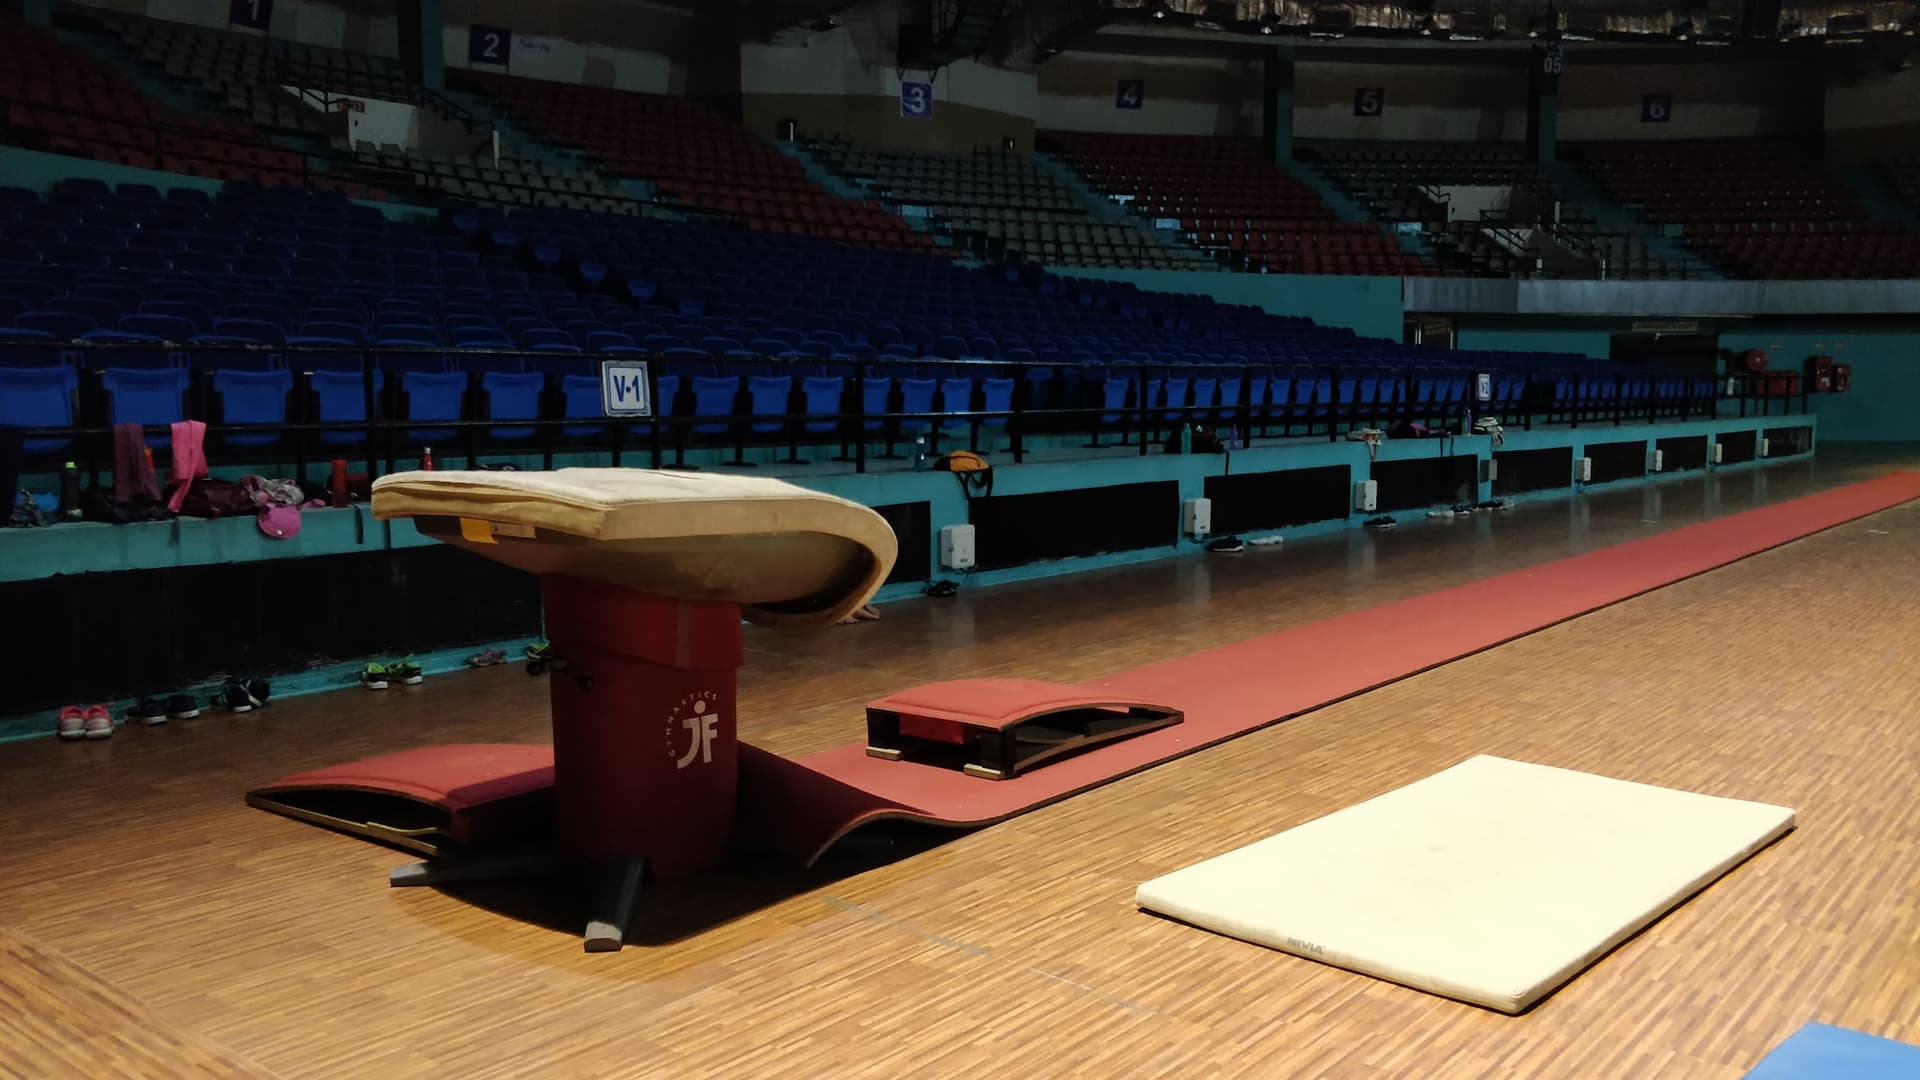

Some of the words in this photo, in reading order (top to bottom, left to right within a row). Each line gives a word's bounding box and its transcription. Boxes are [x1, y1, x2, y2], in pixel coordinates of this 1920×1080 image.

[247, 0, 260, 21] 1
[482, 32, 500, 58] 2
[1543, 56, 1561, 75] 05
[910, 86, 925, 113] 3
[1122, 83, 1138, 105] 4
[1360, 91, 1378, 112] 5
[1649, 99, 1664, 119] 6
[1286, 936, 1322, 955] NIVIA
